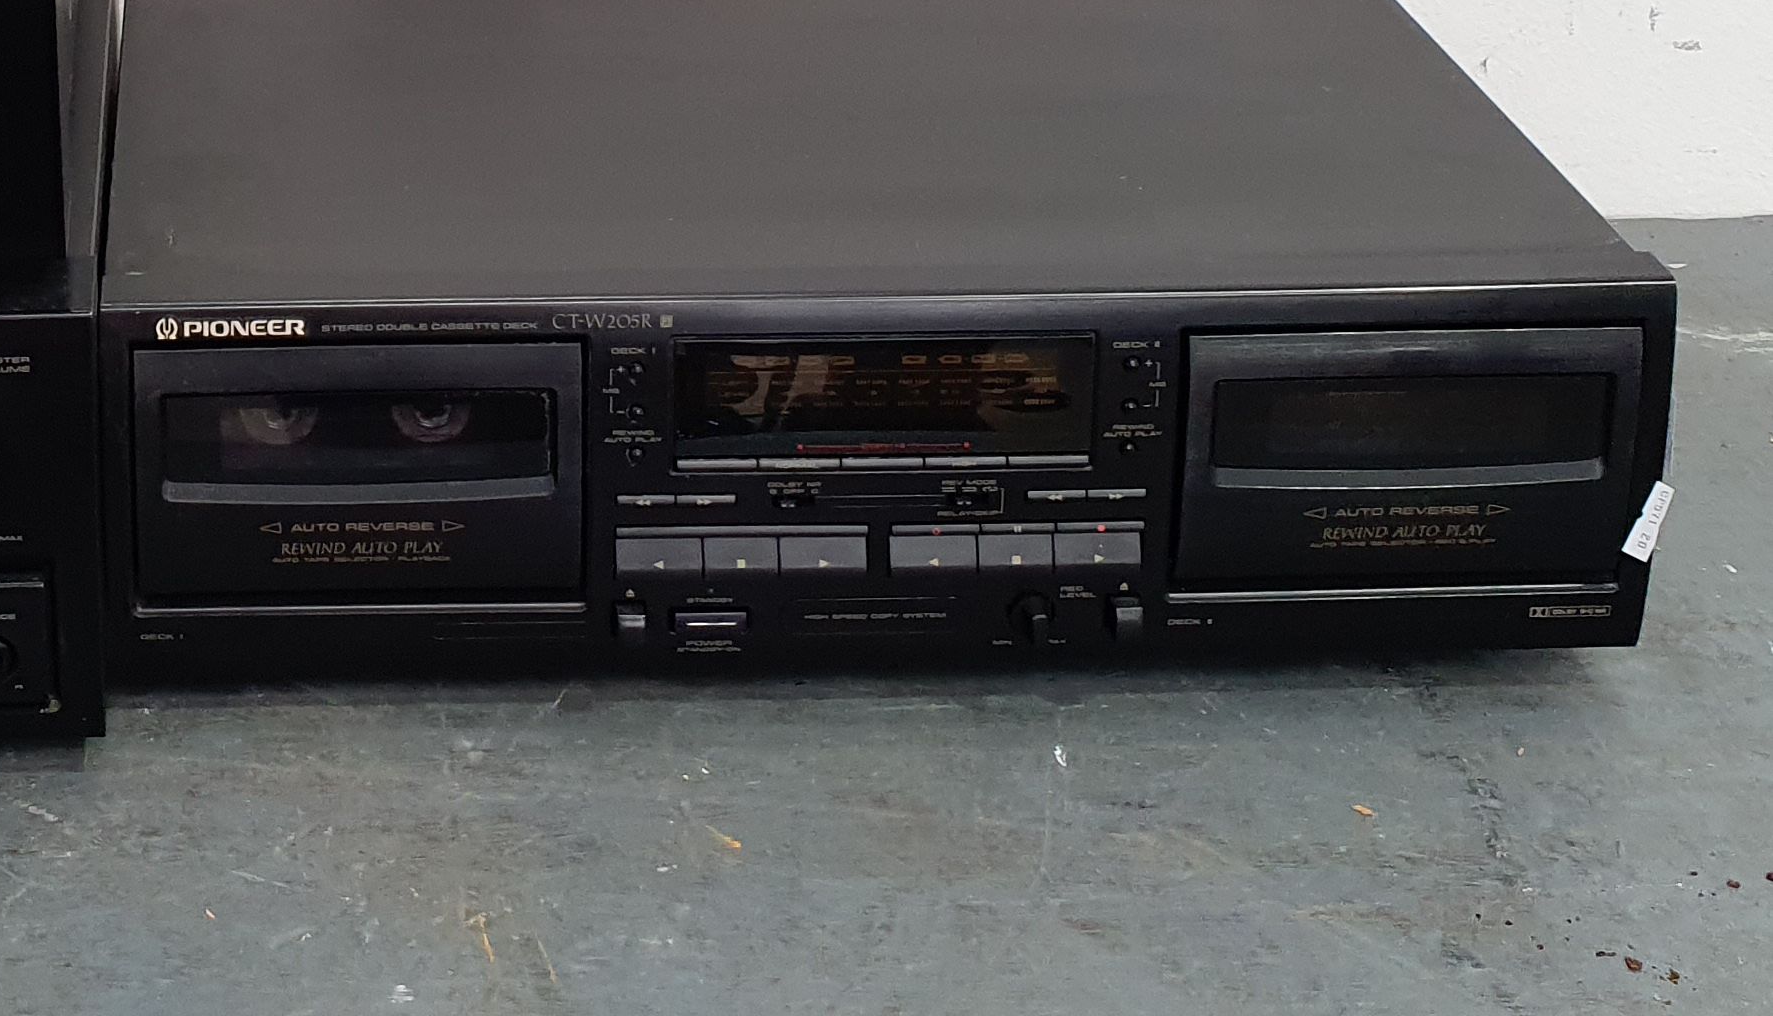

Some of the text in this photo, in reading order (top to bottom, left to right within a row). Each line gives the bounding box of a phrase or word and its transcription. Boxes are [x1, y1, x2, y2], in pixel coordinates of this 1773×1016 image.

[183, 319, 306, 337] PIONEER
[321, 313, 653, 333] STEREO DOUBLE CASSETTE DECK CT-W205R
[610, 347, 646, 355] DECK
[1112, 341, 1149, 349] DECK
[1334, 505, 1480, 518] AUTO REVERSE
[290, 520, 435, 533] AUTO REVERSE
[1321, 523, 1489, 540] REWIND AUTO PLAY
[281, 540, 444, 556] REWIND AUTO PLAY
